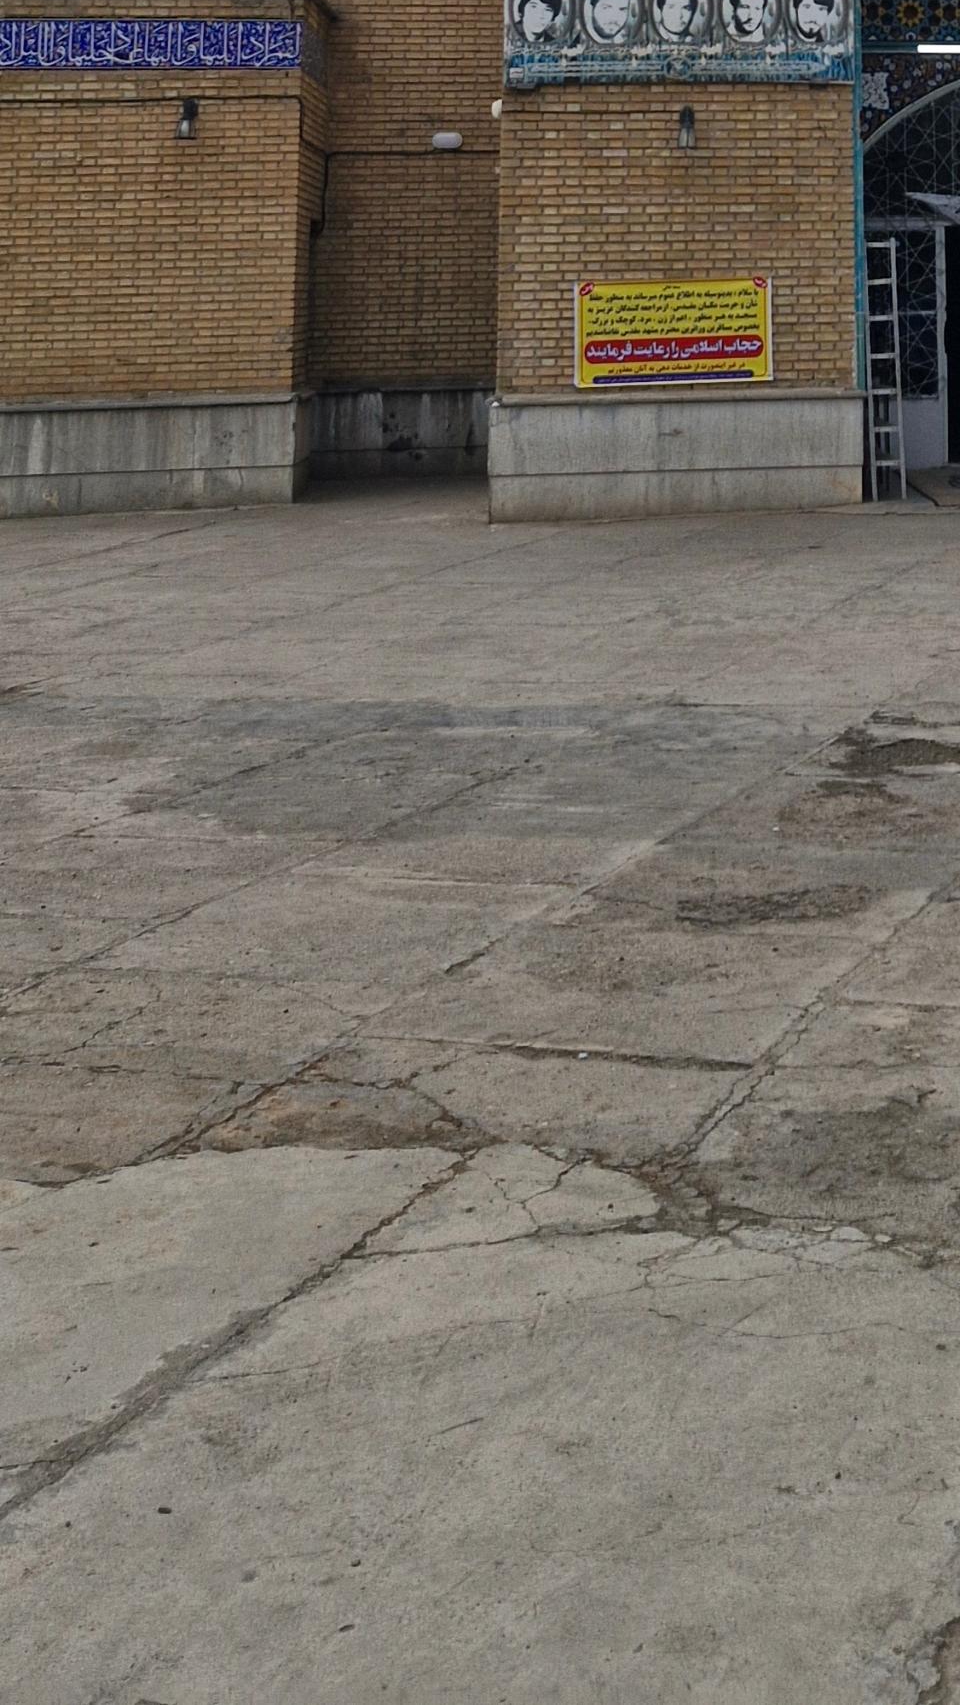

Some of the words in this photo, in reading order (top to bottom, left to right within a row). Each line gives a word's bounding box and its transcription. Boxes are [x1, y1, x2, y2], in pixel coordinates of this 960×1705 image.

[634, 342, 671, 359] رعایت
[671, 340, 680, 358] را
[680, 340, 723, 358] اسلامی
[723, 339, 762, 355] حجاب
